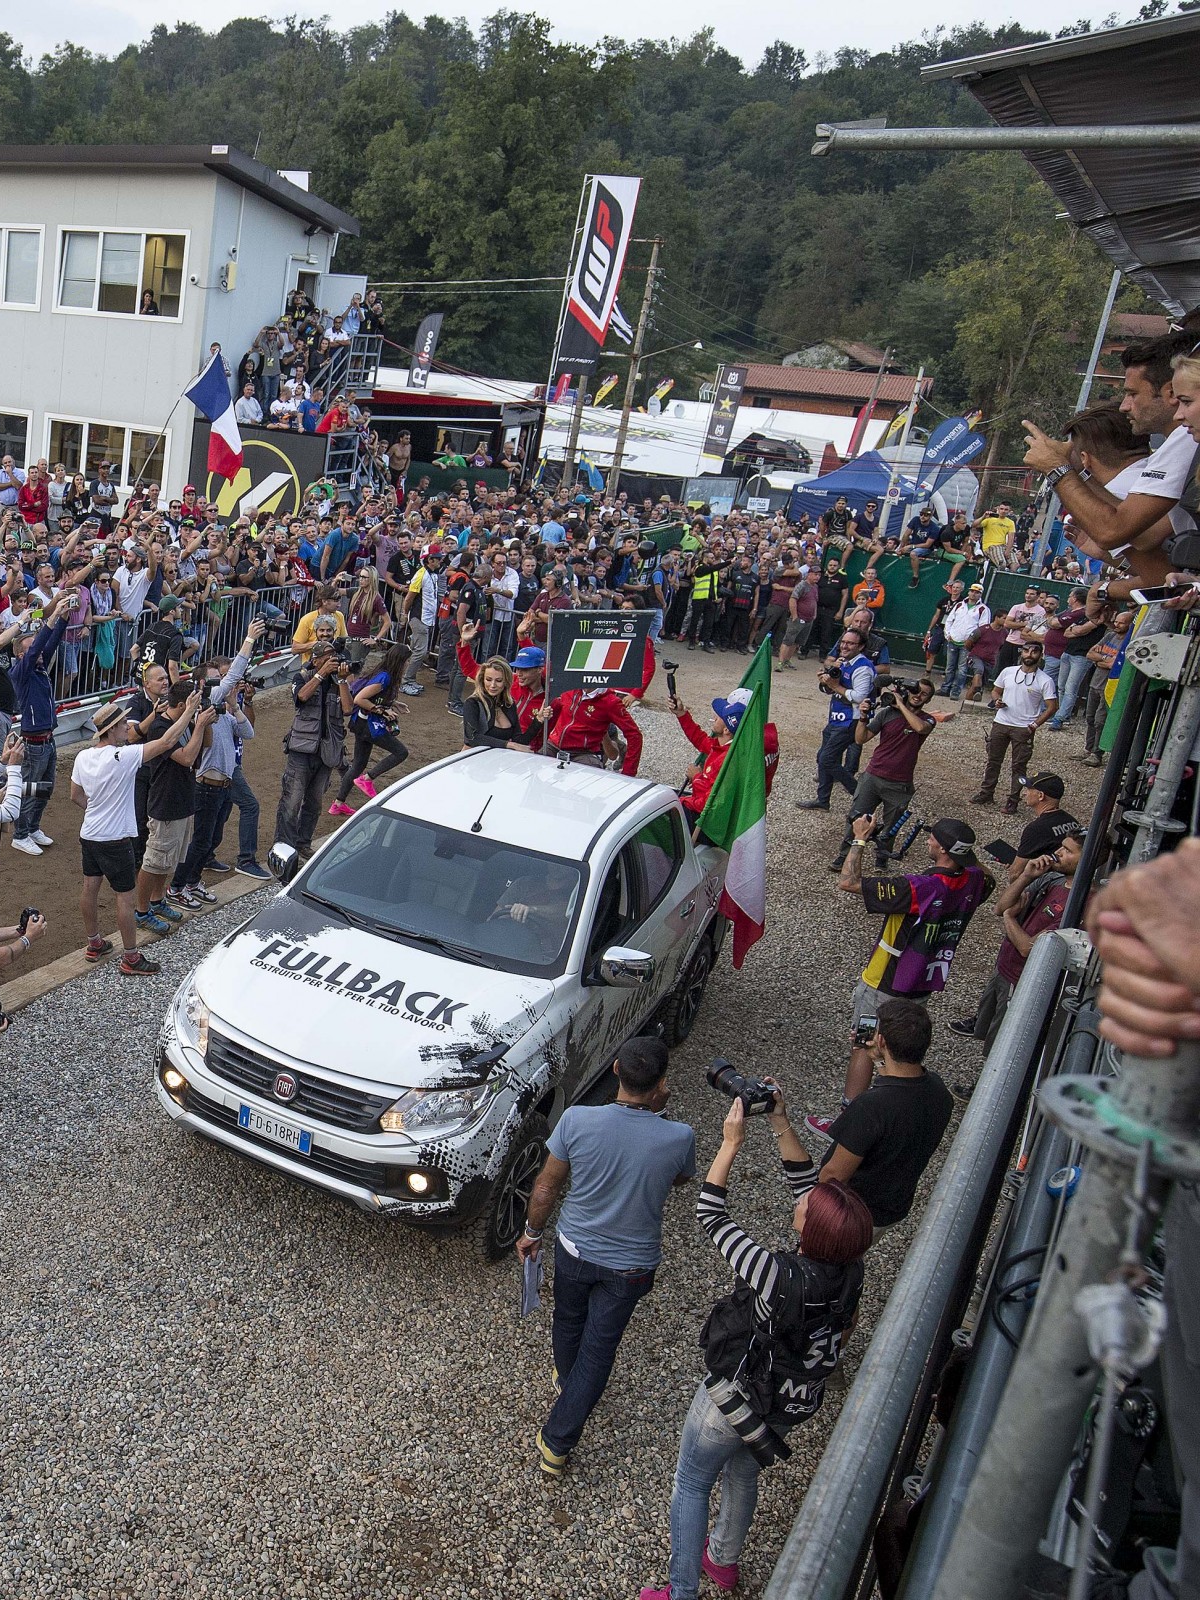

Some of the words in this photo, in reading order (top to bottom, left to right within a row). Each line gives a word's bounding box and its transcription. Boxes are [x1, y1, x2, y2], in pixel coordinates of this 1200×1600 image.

[142, 646, 156, 662] 58
[583, 676, 609, 684] ITALY
[935, 949, 954, 961] 49
[926, 961, 949, 982] TV
[249, 958, 302, 981] COSTRUITO
[302, 977, 323, 988] PER
[324, 984, 335, 993] TE
[344, 991, 365, 1003] PER
[366, 998, 375, 1008] IL
[377, 1002, 400, 1015] TUO
[255, 939, 469, 1027] FULLBACK
[277, 1080, 293, 1095] FIAT
